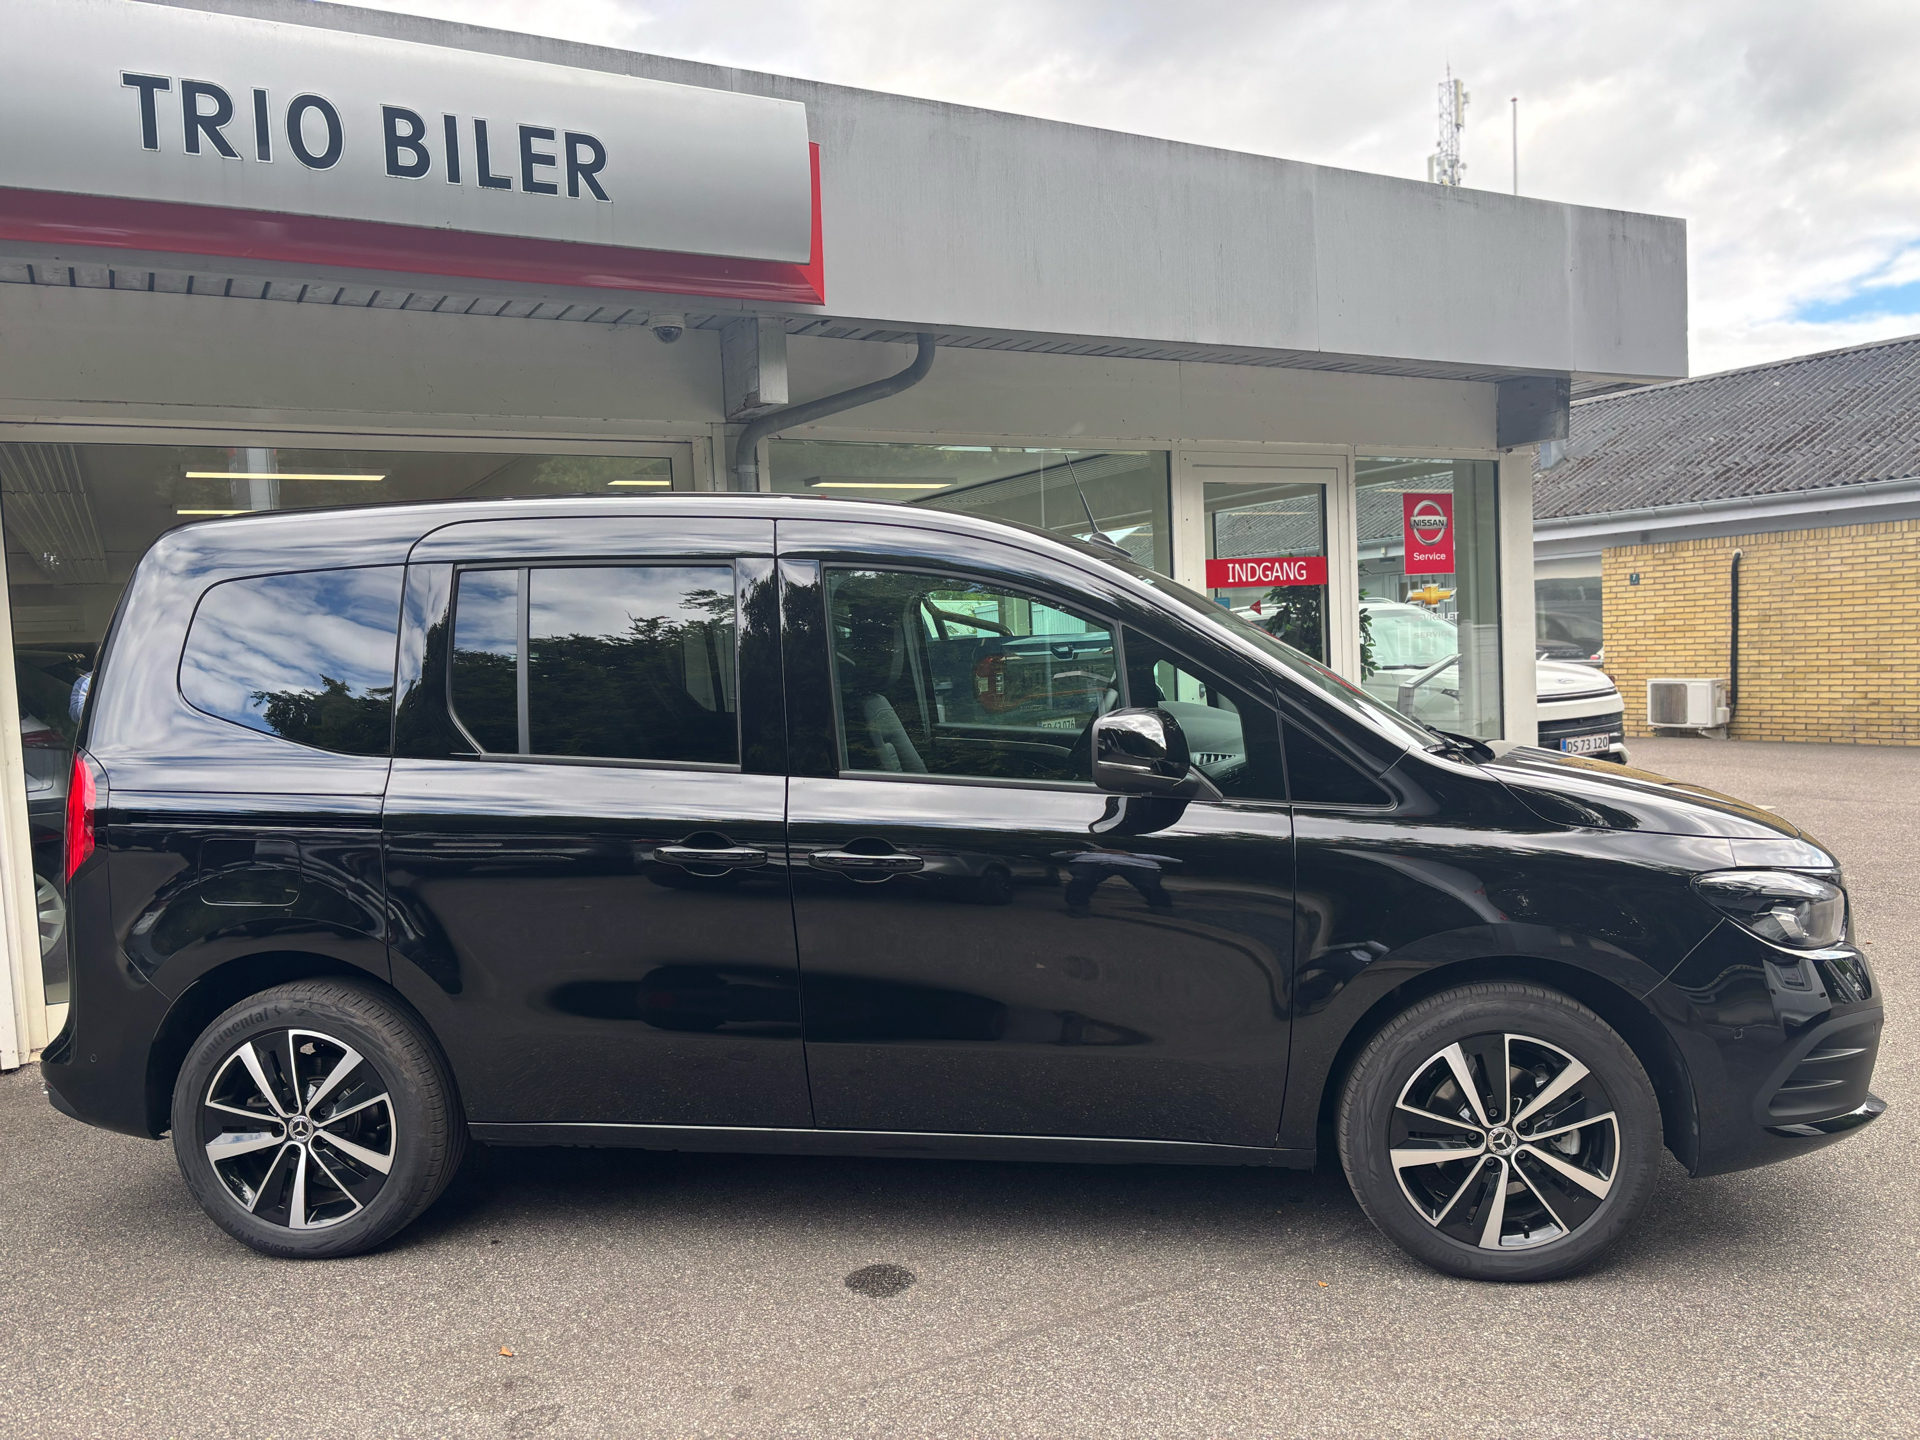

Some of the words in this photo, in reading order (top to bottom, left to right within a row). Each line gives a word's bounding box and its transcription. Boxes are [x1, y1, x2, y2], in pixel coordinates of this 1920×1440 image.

[120, 70, 345, 170] TRIO
[380, 103, 613, 203] BILER
[1412, 519, 1446, 527] NISSAN
[1413, 551, 1446, 561] Service
[1227, 561, 1307, 583] INDGANG
[1408, 611, 1459, 621] VROLET
[1567, 741, 1579, 753] DS
[1580, 739, 1591, 751] 73
[1593, 737, 1608, 749] 120
[198, 1007, 269, 1066] Continental
[234, 1228, 245, 1238] 17
[246, 1233, 254, 1243] R
[257, 1239, 295, 1254] 205/55
